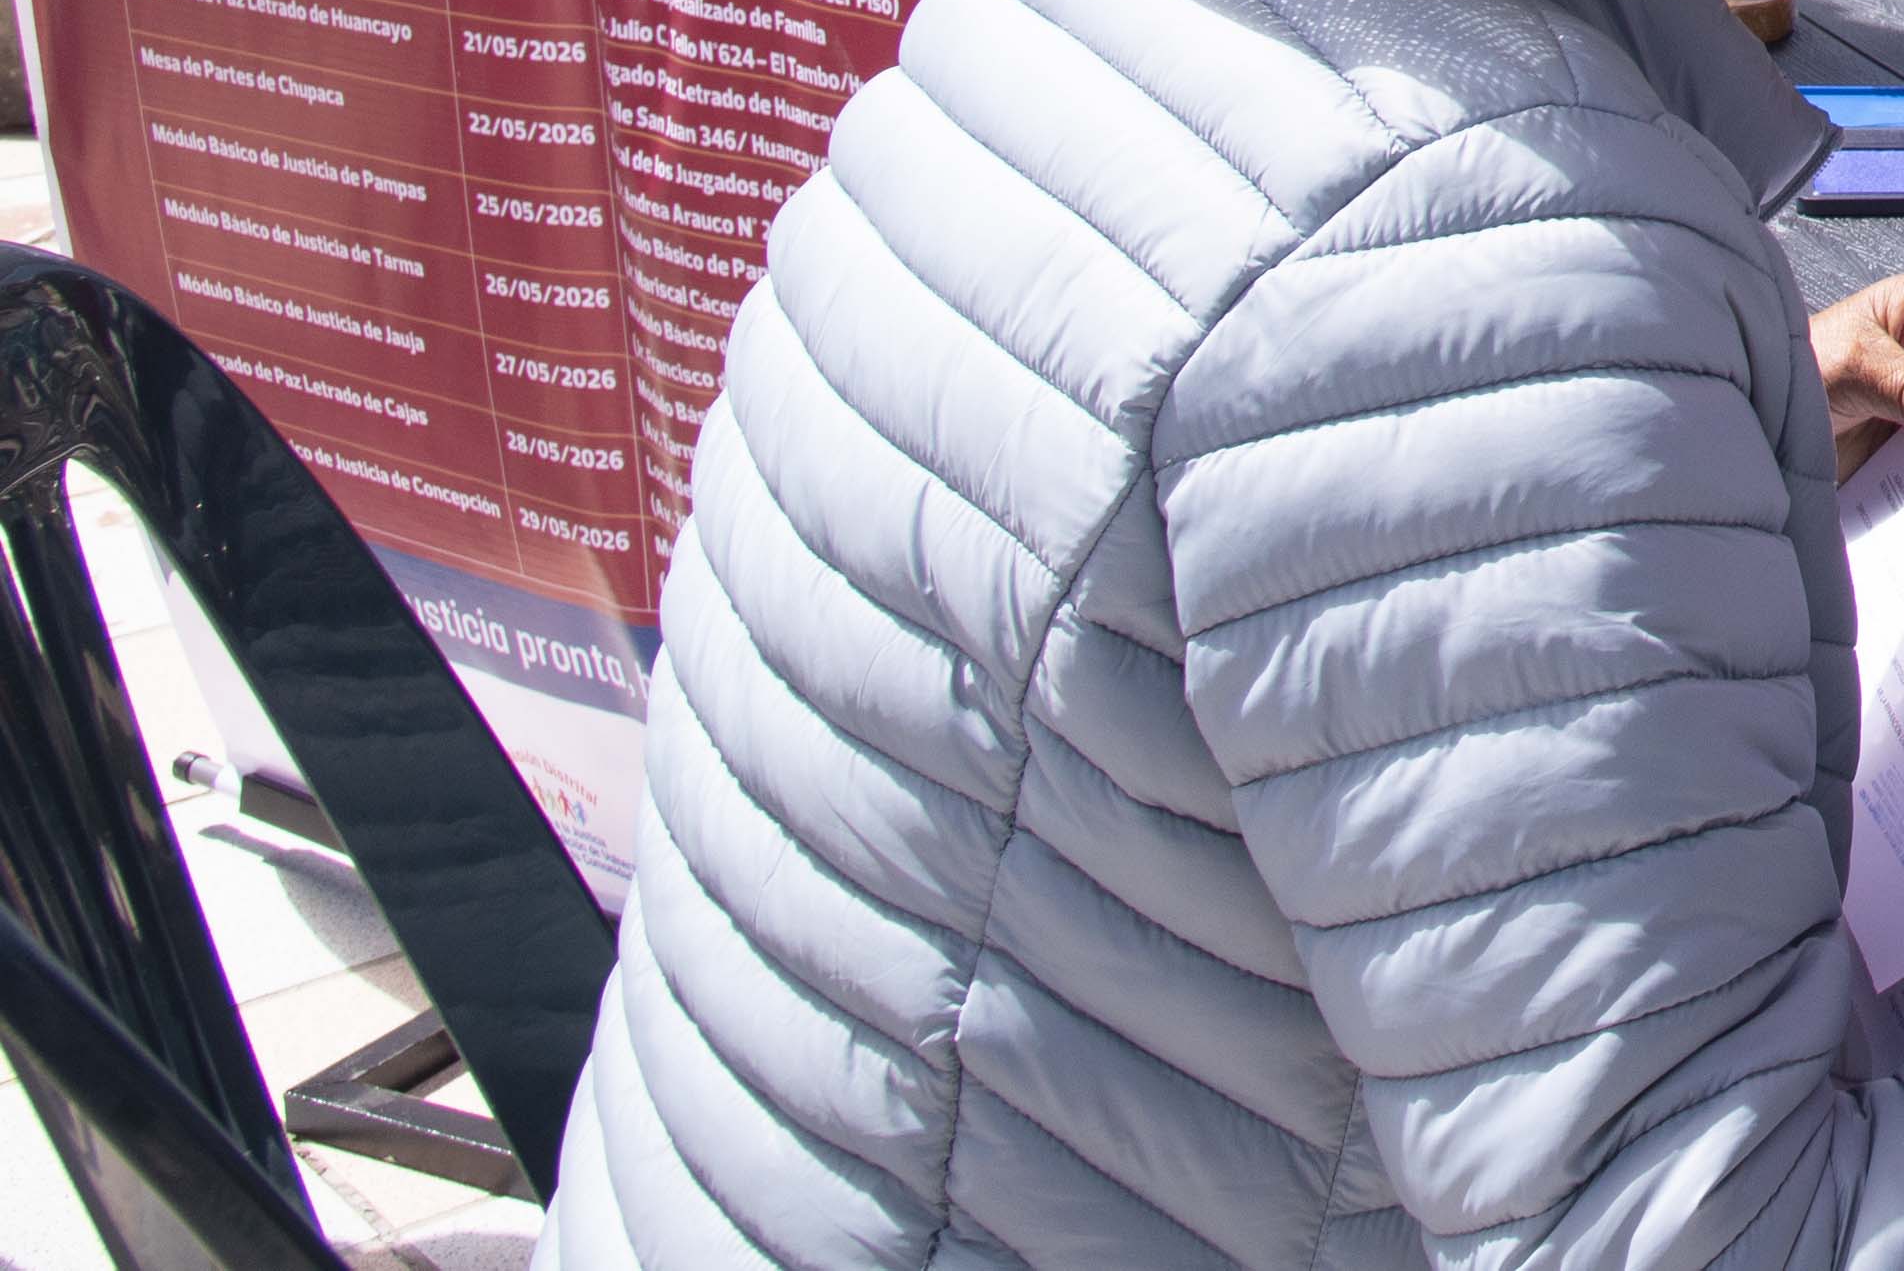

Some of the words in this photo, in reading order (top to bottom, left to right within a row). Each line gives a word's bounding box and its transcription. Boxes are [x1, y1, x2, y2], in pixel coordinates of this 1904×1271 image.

[140, 46, 181, 73] Mesa
[183, 54, 201, 76] de
[203, 59, 254, 90] Partes
[257, 70, 276, 91] de
[278, 75, 344, 107] Chupaca
[469, 111, 596, 147] 22/05/2026
[165, 197, 218, 230] Módulo
[220, 210, 270, 245] Básico
[273, 226, 291, 246] de
[294, 229, 349, 260] Justicia
[351, 243, 370, 264] de
[374, 247, 424, 278] Tarma
[484, 273, 611, 310] 26/05/2026
[408, 595, 509, 654] usticia
[517, 629, 634, 691] pronta,
